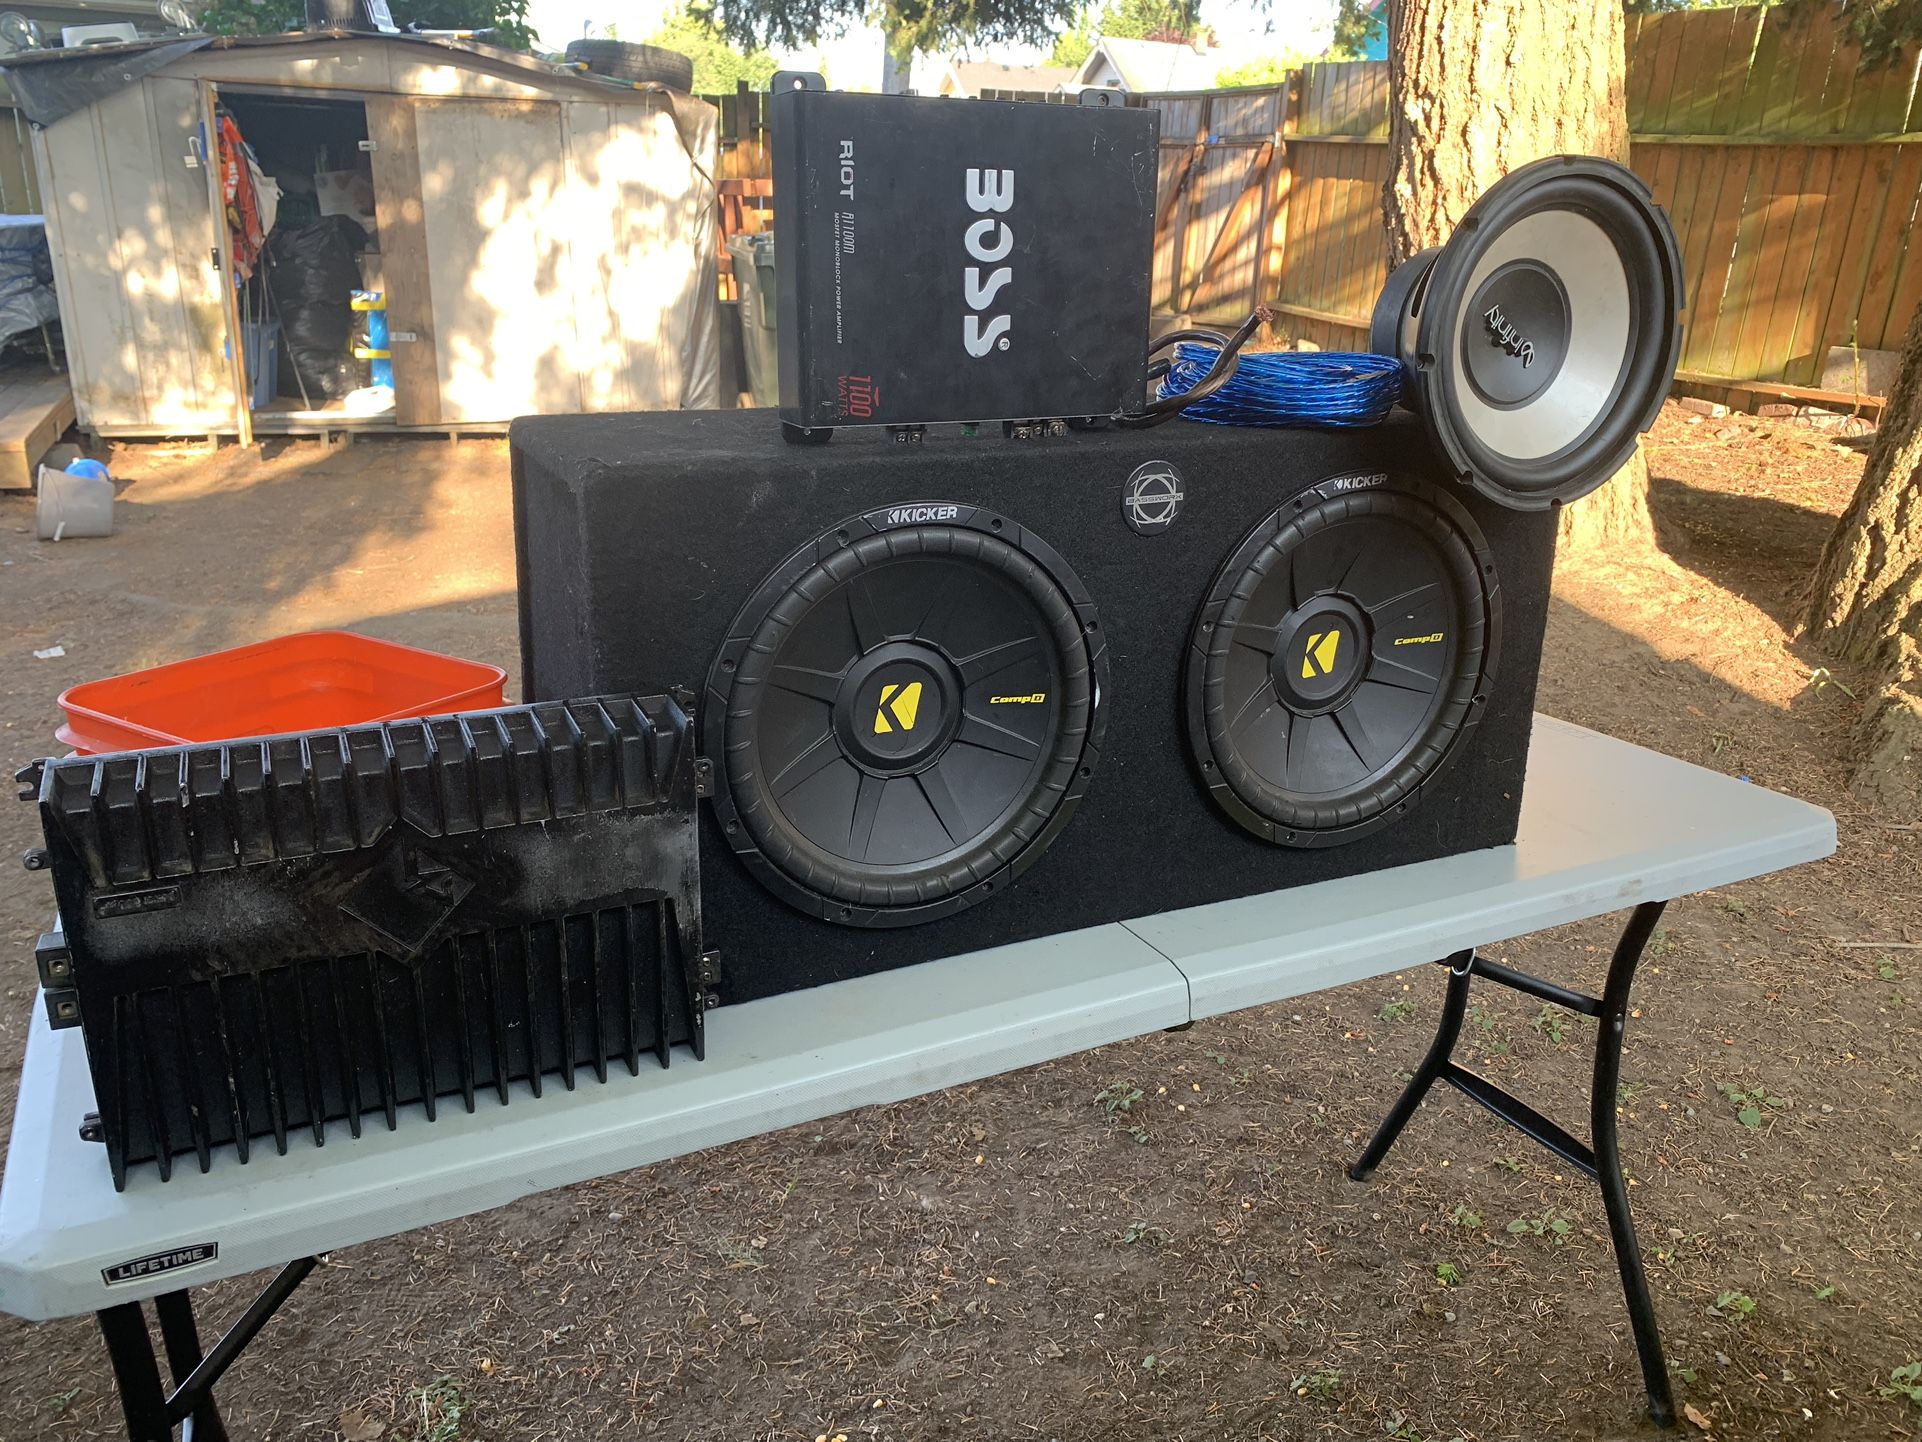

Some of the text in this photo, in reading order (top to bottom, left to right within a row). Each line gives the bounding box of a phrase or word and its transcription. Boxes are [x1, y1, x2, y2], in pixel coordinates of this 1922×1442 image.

[838, 140, 855, 200] RIOT
[964, 168, 1015, 358] BOSS
[1484, 304, 1525, 354] Infinity
[838, 375, 848, 417] WATTS
[849, 375, 871, 417] 1100
[1127, 494, 1183, 504] BASSWORX
[1343, 473, 1388, 490] KICKER
[899, 505, 958, 523] KICKER
[118, 1248, 205, 1278] LIFETIME
